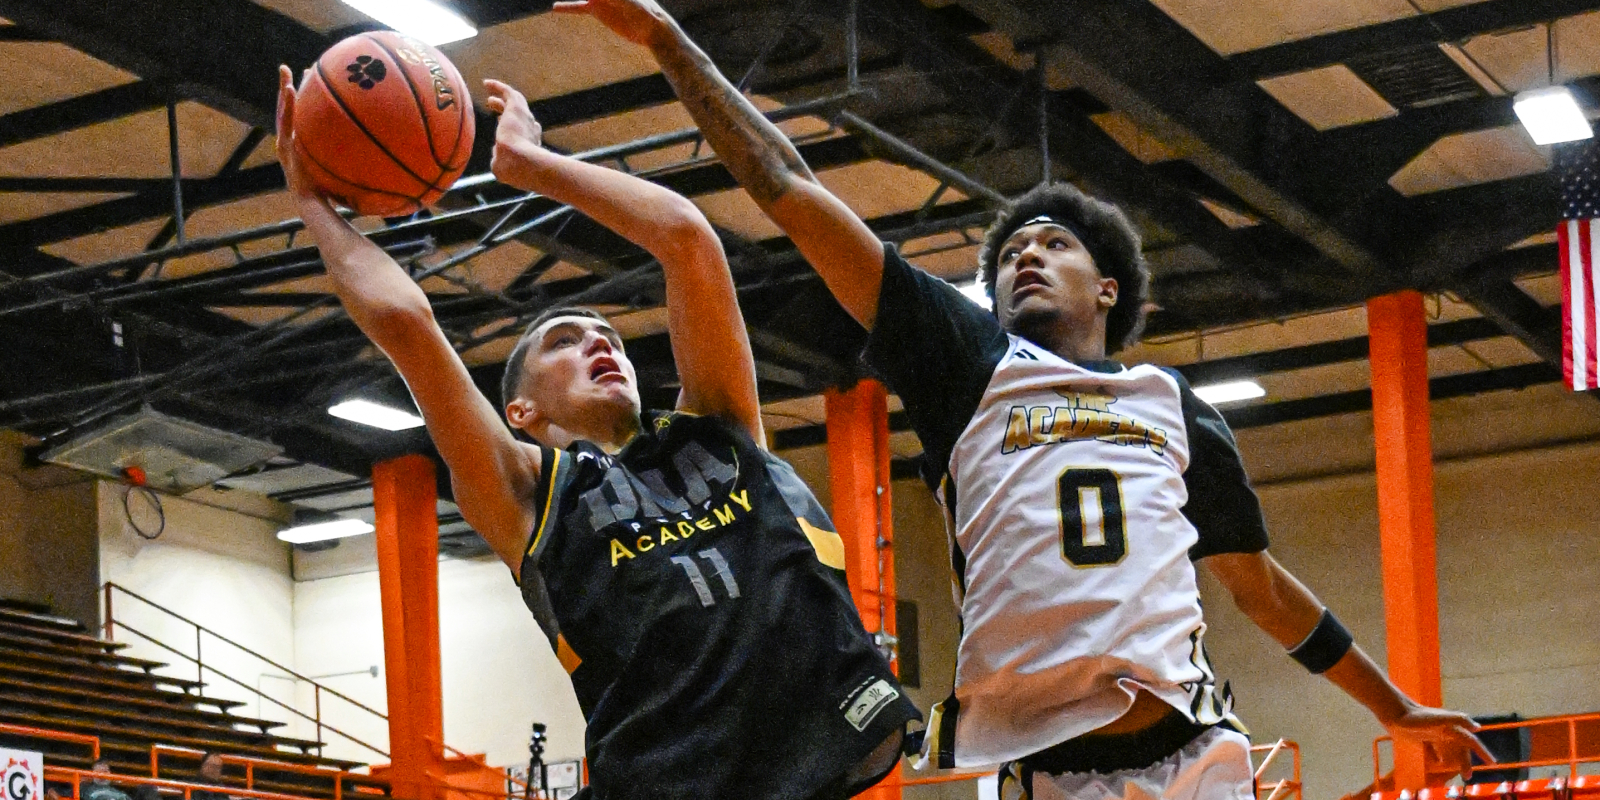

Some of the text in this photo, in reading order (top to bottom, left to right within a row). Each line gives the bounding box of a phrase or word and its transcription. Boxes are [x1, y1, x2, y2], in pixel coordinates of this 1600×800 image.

[400, 35, 454, 110] SPAL
[1001, 406, 1168, 456] ACADEMY
[579, 440, 738, 531] DNA
[1056, 465, 1129, 569] 0
[610, 489, 752, 567] ACADEMY
[670, 547, 741, 608] 11
